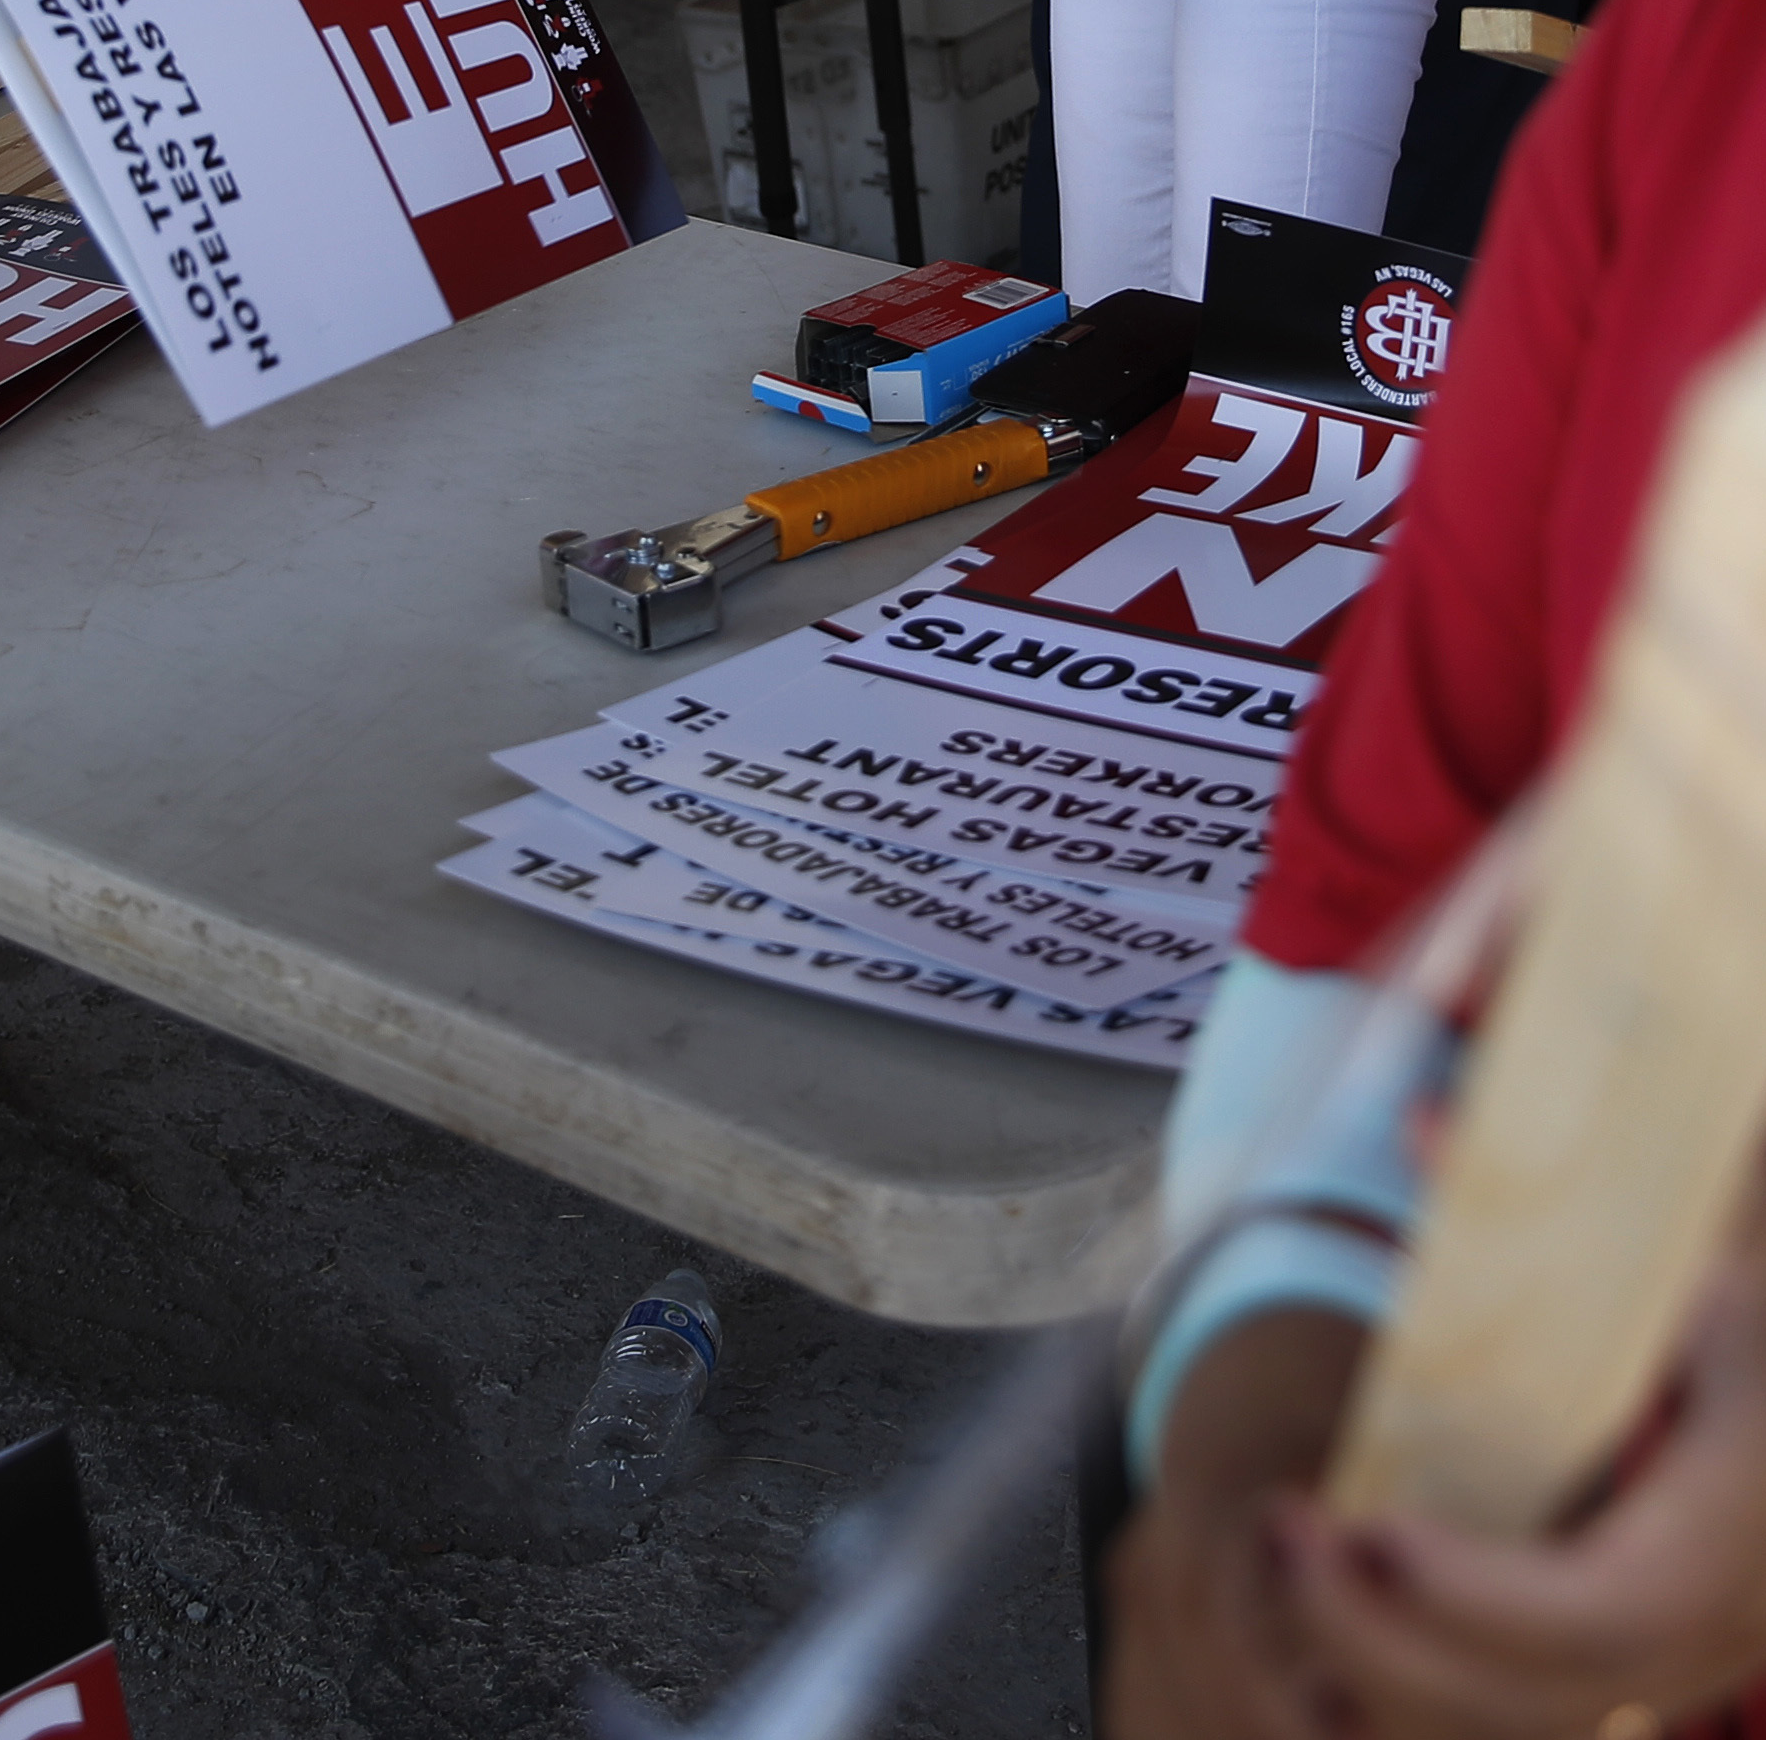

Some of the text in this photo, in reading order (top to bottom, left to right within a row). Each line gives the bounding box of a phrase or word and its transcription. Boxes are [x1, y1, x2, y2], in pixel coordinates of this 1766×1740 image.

[132, 19, 208, 119] LAS
[131, 97, 173, 131] Y
[191, 134, 243, 206] EN
[151, 142, 281, 372] HOTELES
[165, 258, 232, 355] LOS
[1431, 276, 1454, 299] LAS
[1340, 304, 1357, 336] #165
[1342, 337, 1369, 376] LOCAL
[581, 759, 660, 797] DE
[702, 749, 1214, 885] VEGAS HOTEL
[649, 789, 1014, 946] TRABAJADORES
[943, 867, 991, 893] Y
[684, 879, 772, 914] DE
[986, 882, 1217, 963] HOTELES
[1010, 934, 1126, 978] LOS
